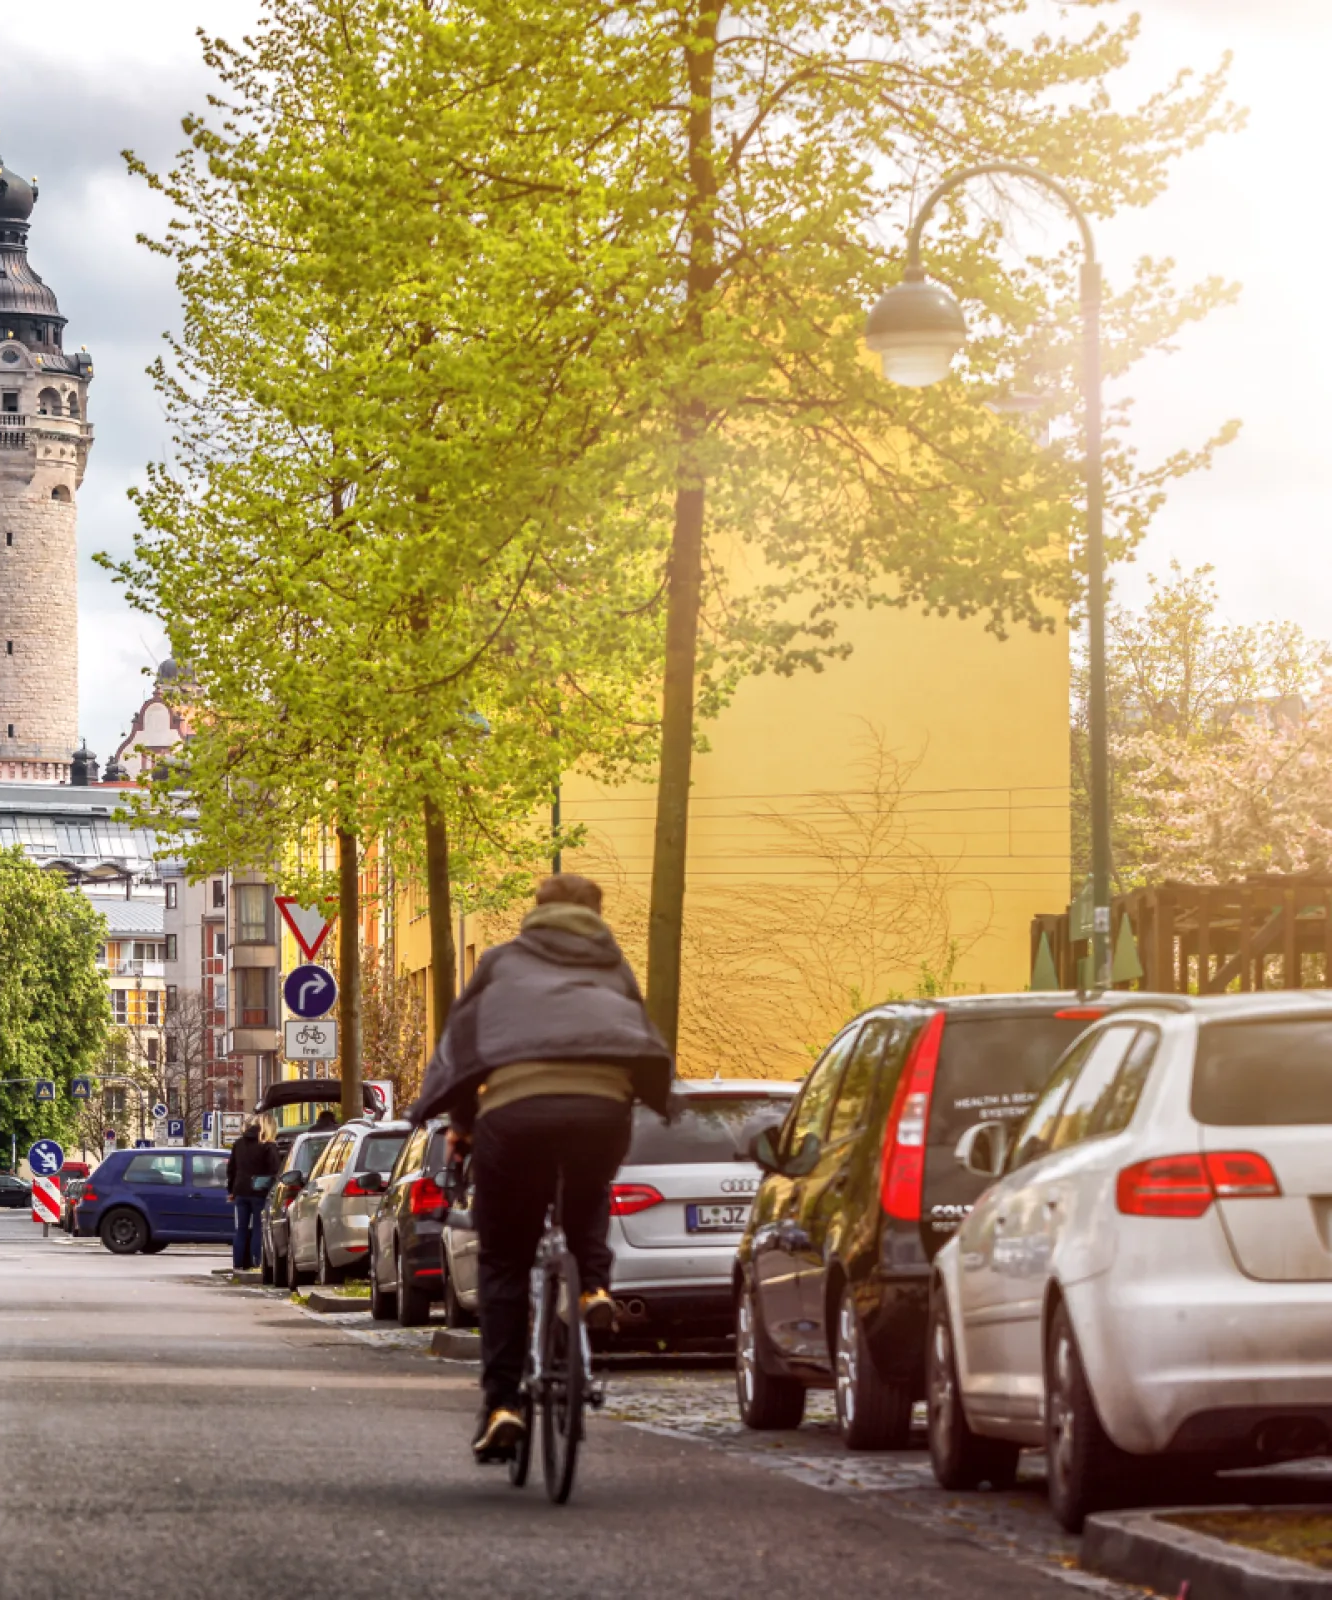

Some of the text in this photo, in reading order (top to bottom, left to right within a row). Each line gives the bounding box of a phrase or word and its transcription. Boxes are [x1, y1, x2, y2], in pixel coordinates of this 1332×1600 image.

[954, 1096, 999, 1109] HEALTH
[1002, 1094, 1009, 1103] &
[171, 1121, 180, 1135] P
